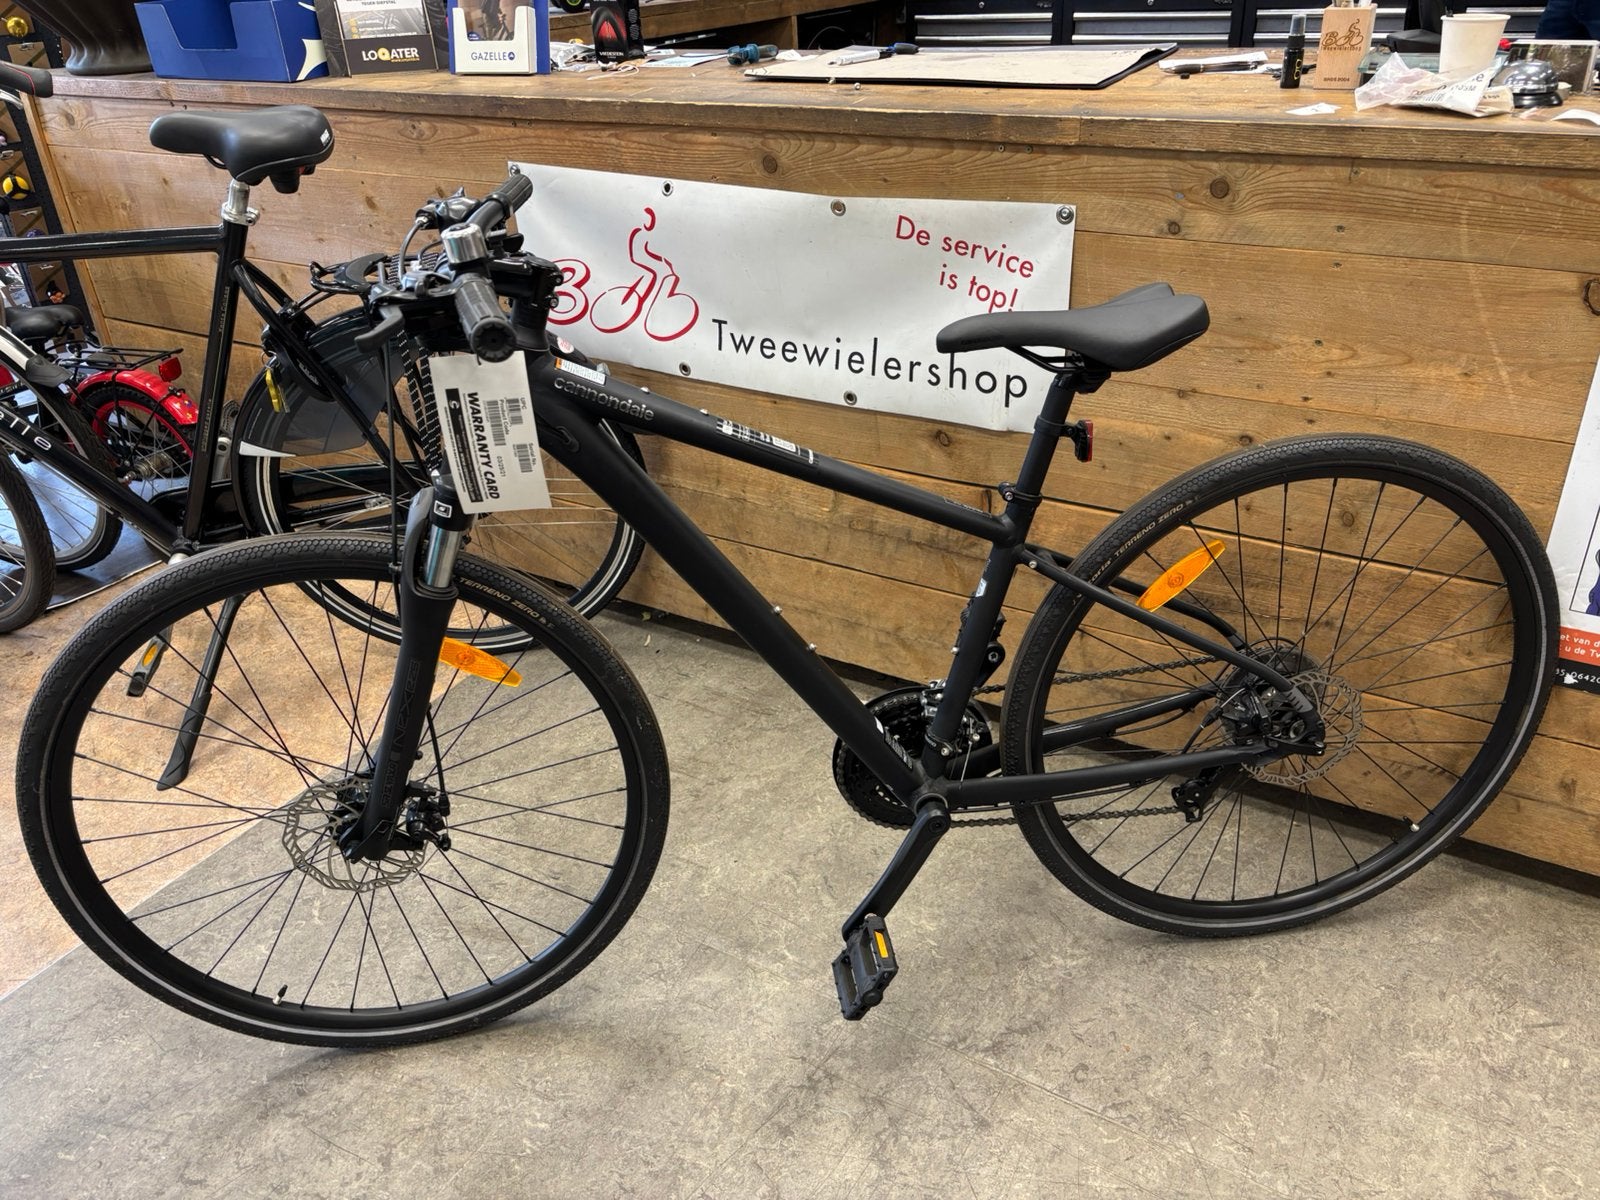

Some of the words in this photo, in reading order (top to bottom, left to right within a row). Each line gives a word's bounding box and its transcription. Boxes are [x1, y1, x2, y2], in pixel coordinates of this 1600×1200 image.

[471, 51, 507, 61] GAZELLE
[896, 215, 931, 246] De
[941, 236, 1034, 278] service
[940, 263, 958, 290] is
[968, 275, 1018, 313] top!
[712, 318, 1028, 408] Tweewielershop
[498, 398, 508, 420] Product
[553, 376, 655, 421] cannondale
[466, 391, 494, 468] WARRANTY
[483, 469, 500, 500] CARD
[502, 420, 510, 435] Code
[1114, 522, 1157, 557] TERRENO
[1157, 503, 1184, 523] ZERO
[460, 577, 511, 601] TERRENO
[511, 599, 540, 618] ZERO
[1574, 637, 1591, 646] van
[1574, 647, 1586, 655] de
[1590, 649, 1600, 659] Tw
